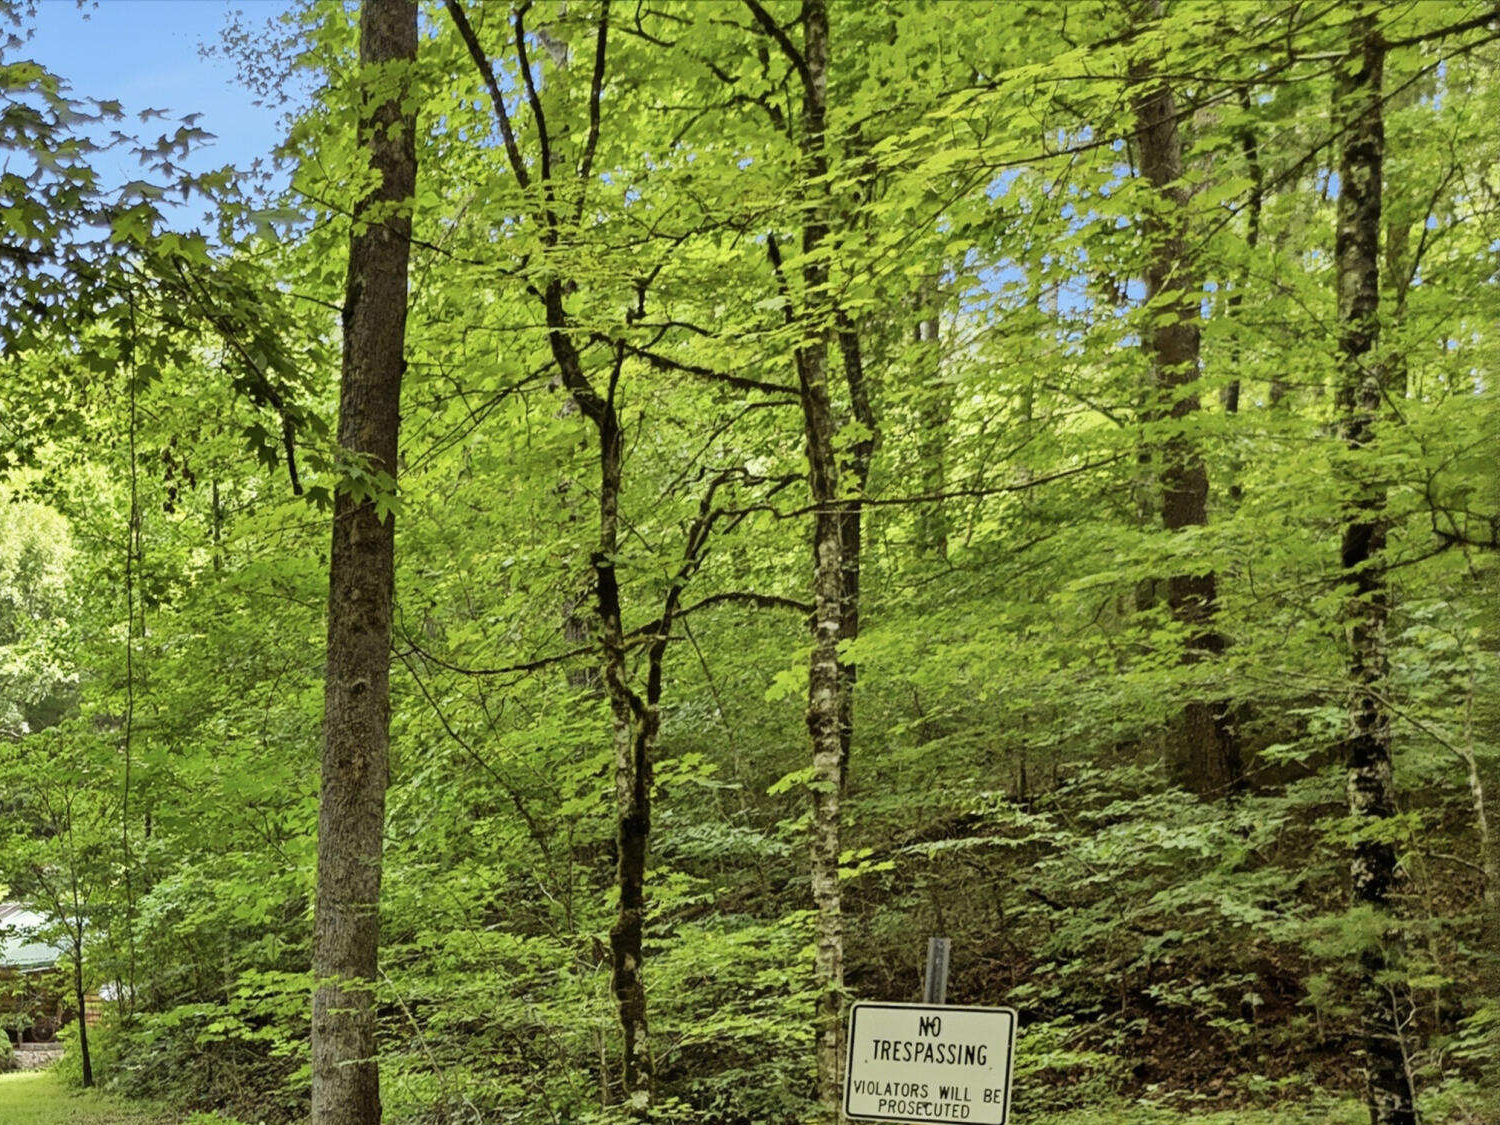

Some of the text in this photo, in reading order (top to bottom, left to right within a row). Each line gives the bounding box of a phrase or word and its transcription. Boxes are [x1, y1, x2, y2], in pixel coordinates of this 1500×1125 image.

[918, 1016, 942, 1037] NO
[872, 1039, 988, 1066] TRESPASSING
[853, 1080, 1002, 1104] VIOLATORS WILL BE
[877, 1099, 970, 1119] PROSECUTED
